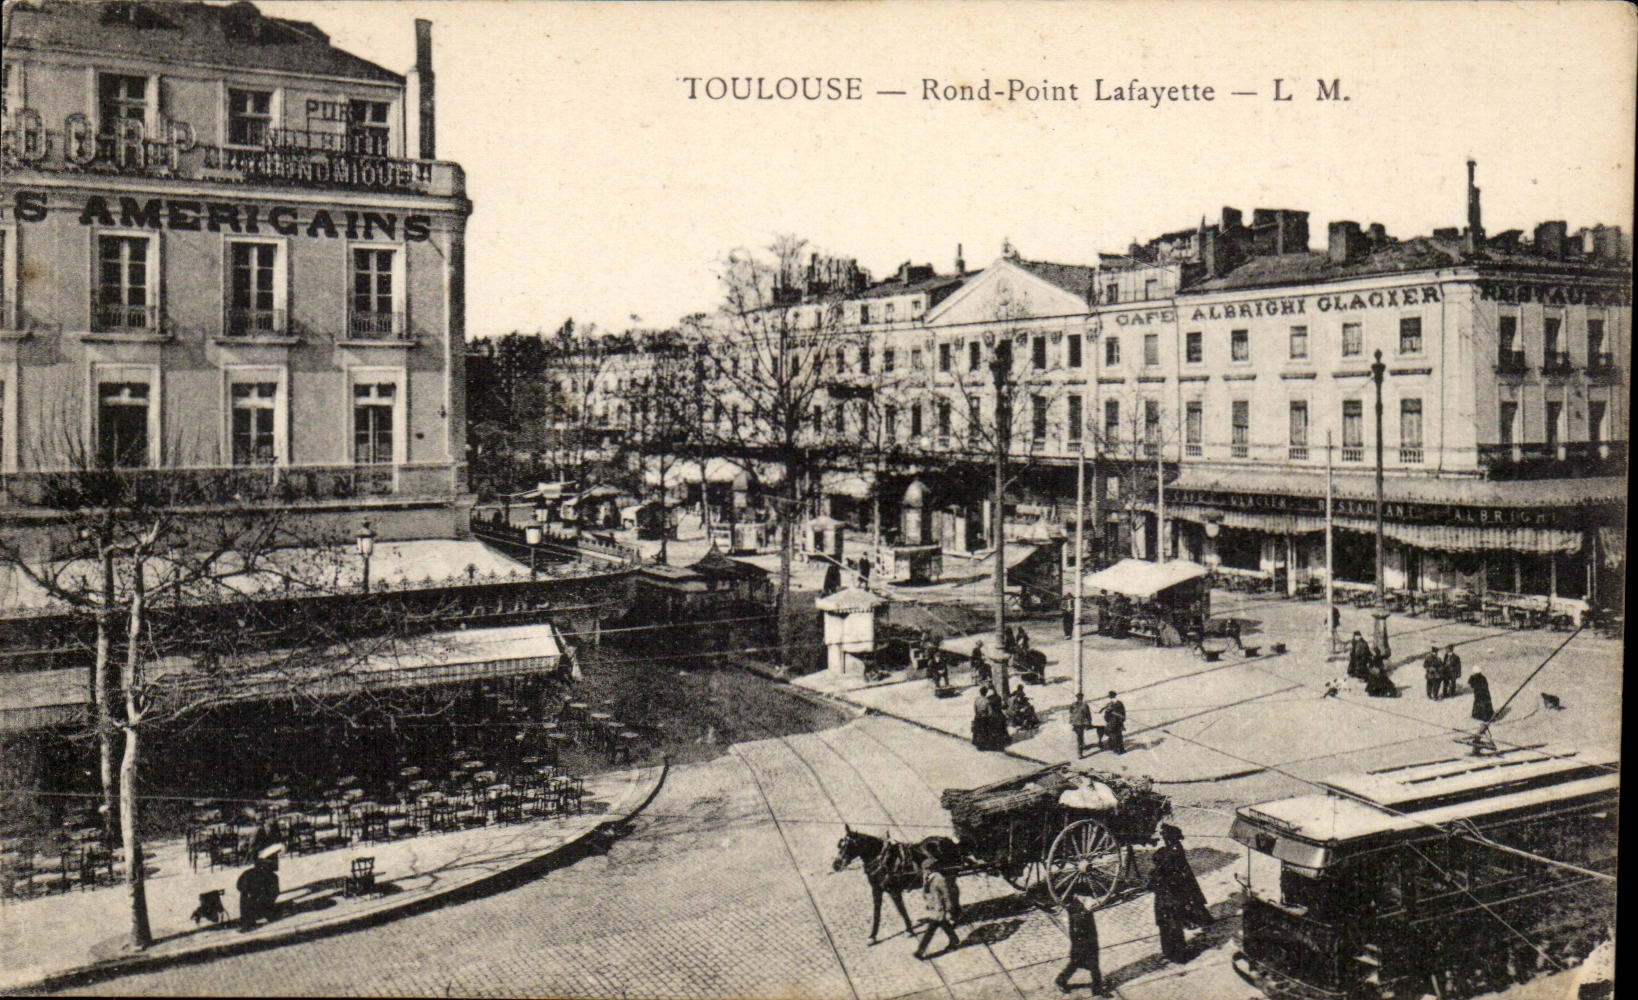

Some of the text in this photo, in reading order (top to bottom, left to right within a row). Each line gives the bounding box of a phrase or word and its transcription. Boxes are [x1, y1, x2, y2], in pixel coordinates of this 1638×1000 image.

[79, 195, 431, 241] AMERICAINS
[1316, 286, 1440, 313] GLACIER
[1319, 499, 1414, 517] RSTAUANT
